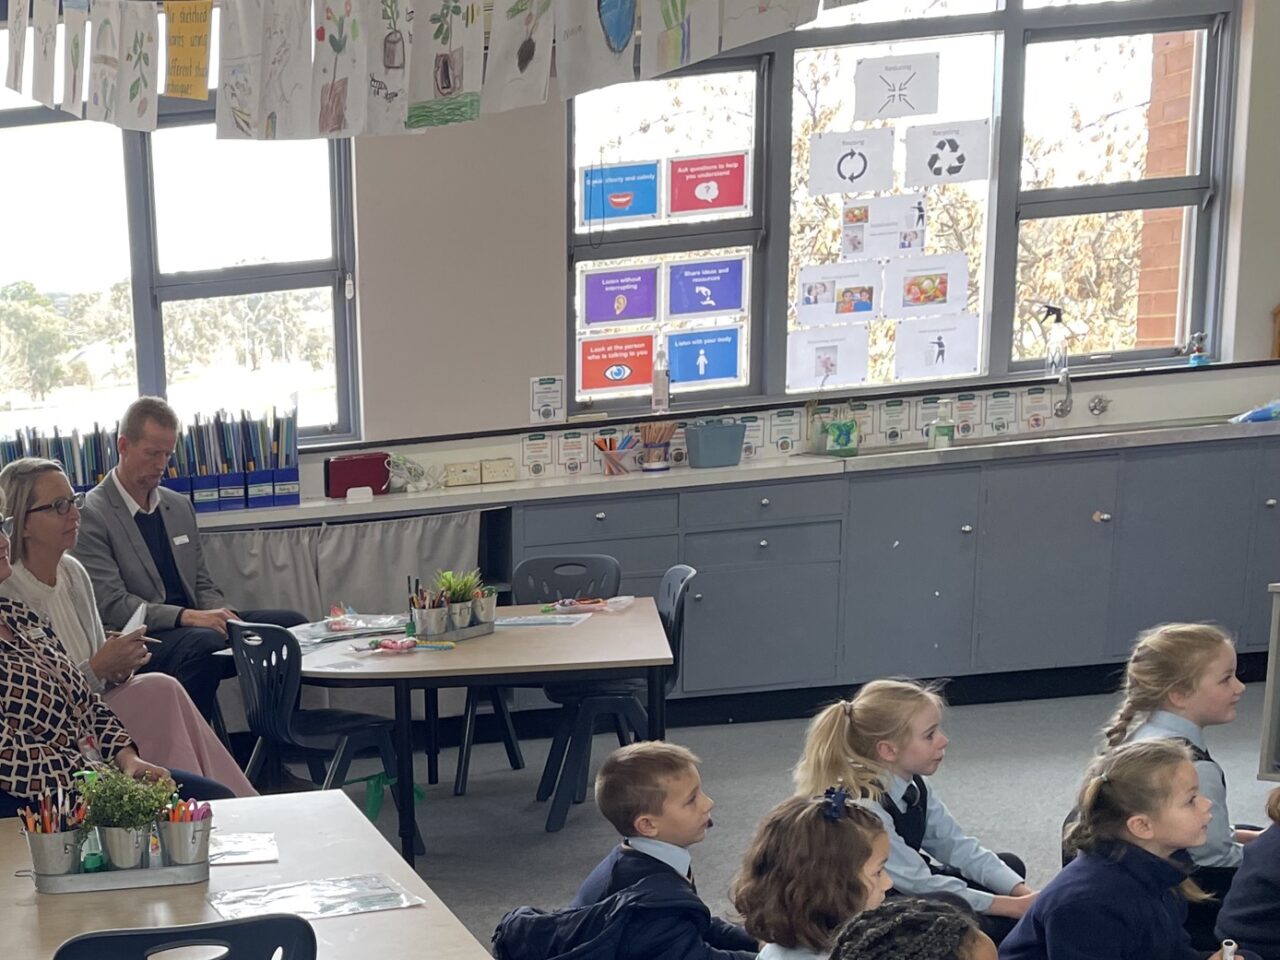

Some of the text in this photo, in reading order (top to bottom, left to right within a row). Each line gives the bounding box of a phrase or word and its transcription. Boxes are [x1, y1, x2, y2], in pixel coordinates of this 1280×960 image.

[689, 164, 717, 174] questions
[725, 161, 739, 170] help
[685, 169, 730, 182] you understand
[684, 266, 730, 278] Share ideas and
[620, 275, 641, 284] without
[605, 284, 638, 293] interrupting
[674, 339, 691, 348] Listen
[703, 338, 716, 346] your
[716, 335, 732, 344] body
[590, 345, 606, 353] Look
[624, 342, 645, 352] person
[608, 352, 628, 360] talking
[636, 350, 648, 359] you
